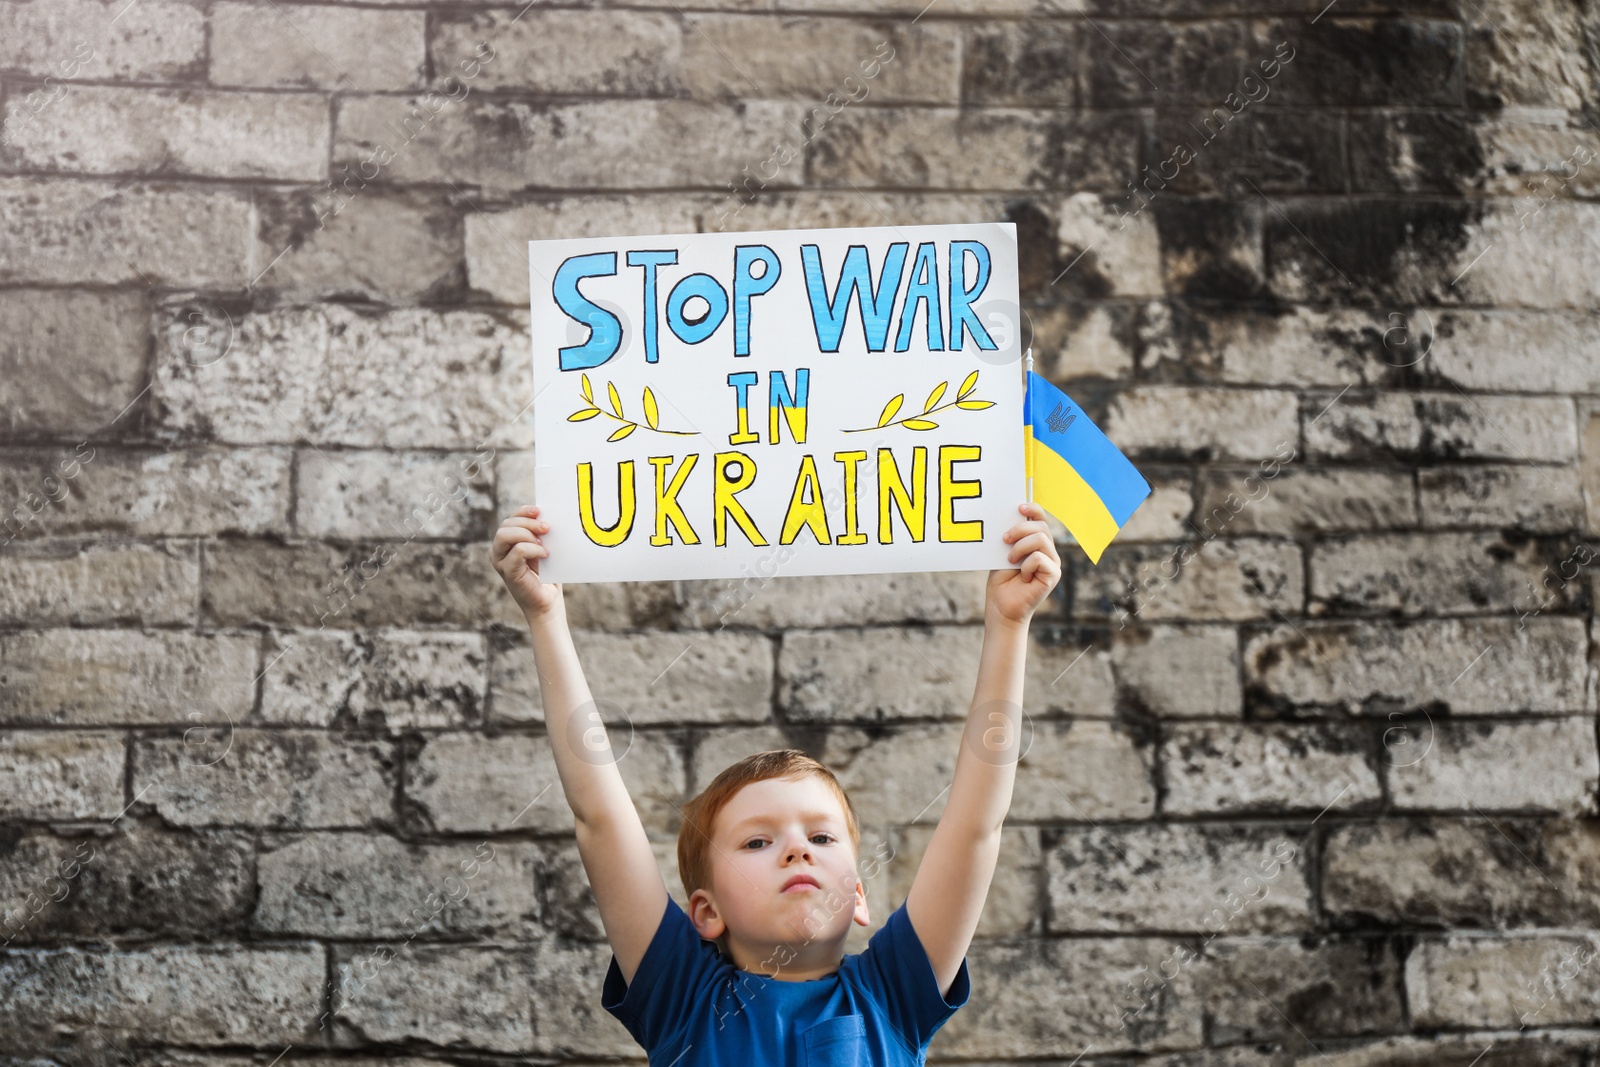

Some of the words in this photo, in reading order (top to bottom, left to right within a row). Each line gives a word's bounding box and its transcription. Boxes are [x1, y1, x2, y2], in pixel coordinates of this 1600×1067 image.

[552, 244, 781, 371] STOP
[800, 239, 998, 354] WAR
[727, 368, 810, 445] IN
[576, 445, 984, 548] UKRAINE
